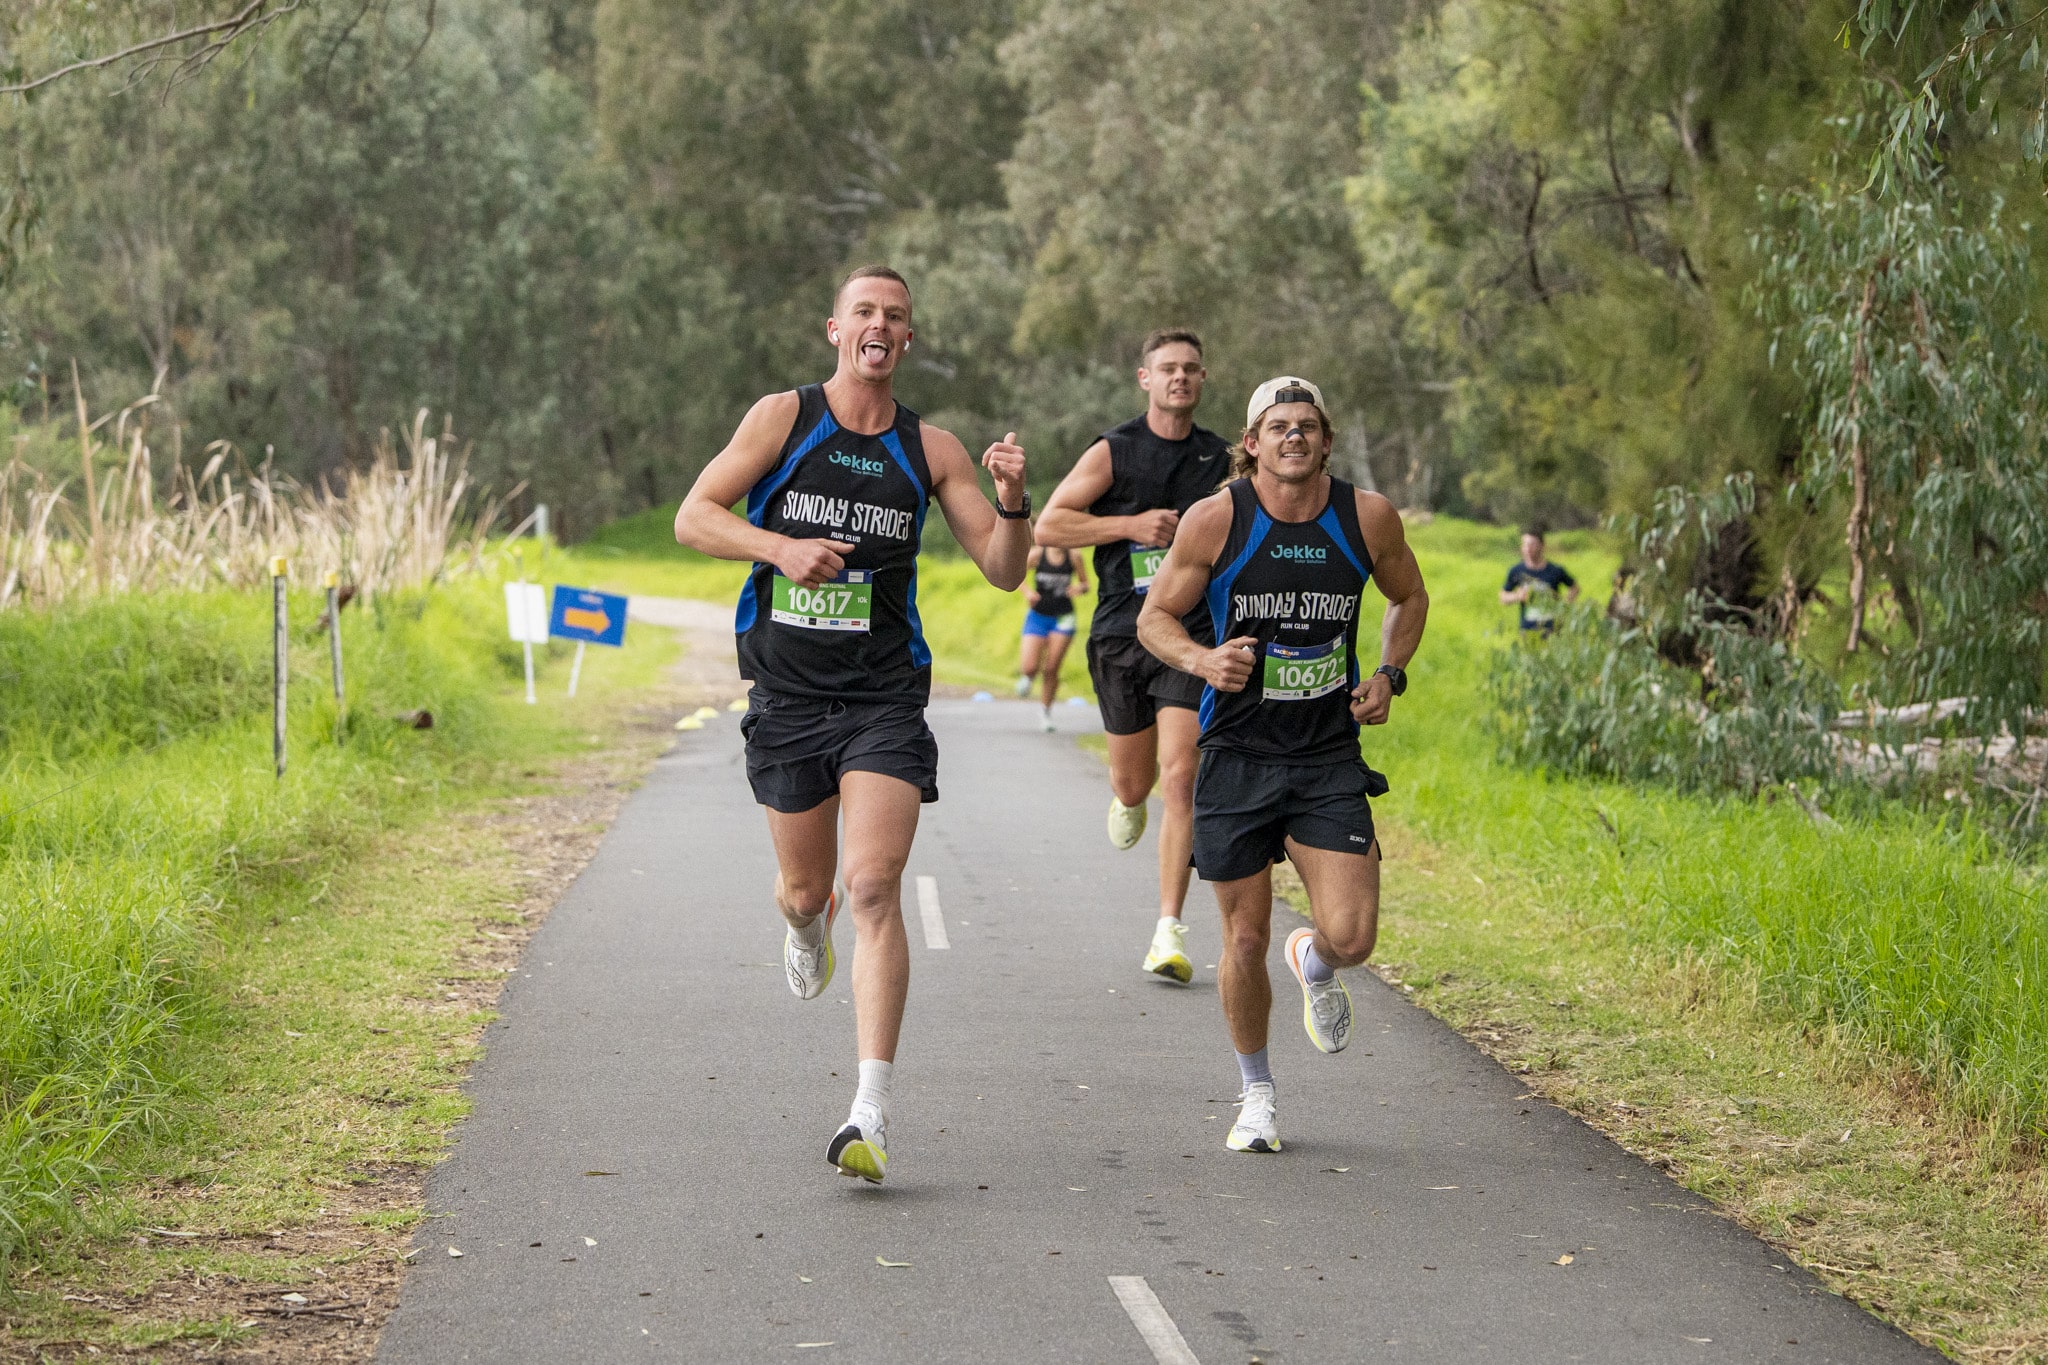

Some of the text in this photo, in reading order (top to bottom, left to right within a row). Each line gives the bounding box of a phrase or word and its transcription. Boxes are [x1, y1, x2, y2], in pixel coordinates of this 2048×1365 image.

[828, 450, 884, 473] Jekka
[782, 490, 912, 541] SUNDAY STRIDES
[830, 531, 861, 543] RUN CLUB
[1270, 544, 1327, 559] Jekka
[788, 586, 853, 615] 10617
[1234, 592, 1358, 622] SUNDAY STRIDES
[1277, 658, 1338, 688] 10672
